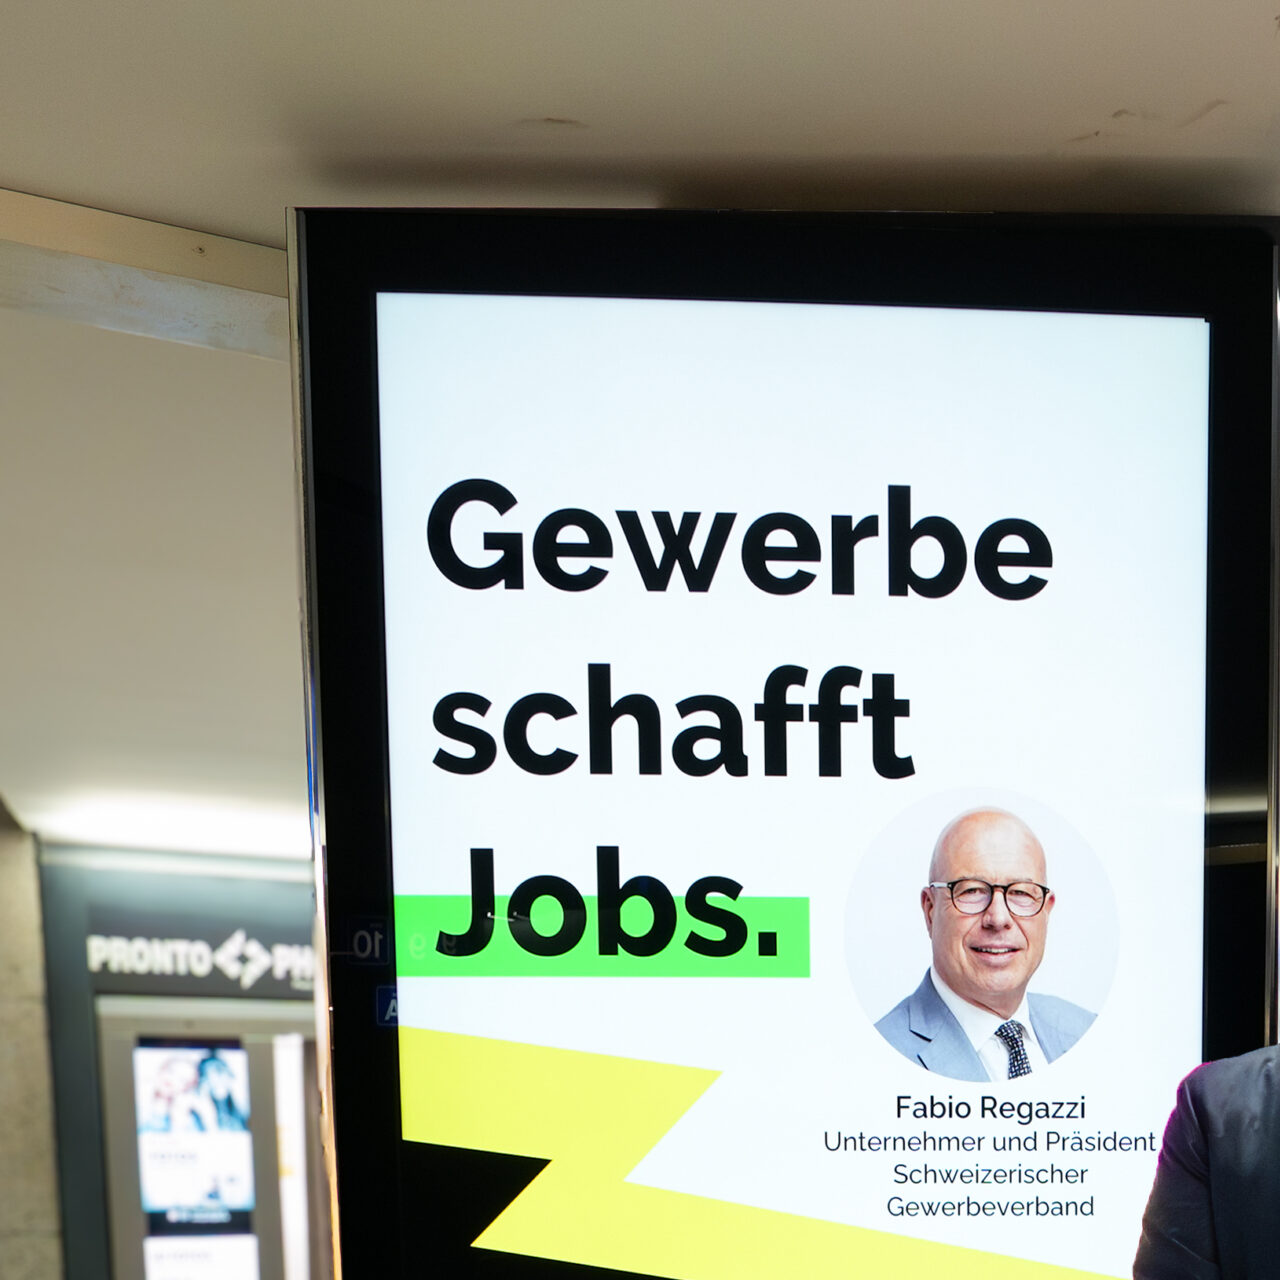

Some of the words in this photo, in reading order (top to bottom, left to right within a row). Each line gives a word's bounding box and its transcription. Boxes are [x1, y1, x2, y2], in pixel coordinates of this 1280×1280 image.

[427, 479, 1053, 601] Gewerbe
[432, 663, 916, 780] schafft
[435, 845, 779, 957] Jobs.
[86, 935, 214, 976] PRONTO
[896, 1096, 972, 1119] Fabio
[981, 1096, 1086, 1126] Regazzi
[824, 1130, 986, 1152] Unternehmer
[992, 1130, 1038, 1152] und
[1046, 1131, 1157, 1153] Präsident
[893, 1163, 1089, 1185] Schweizerischer
[887, 1195, 1094, 1217] Gewerbeverband
